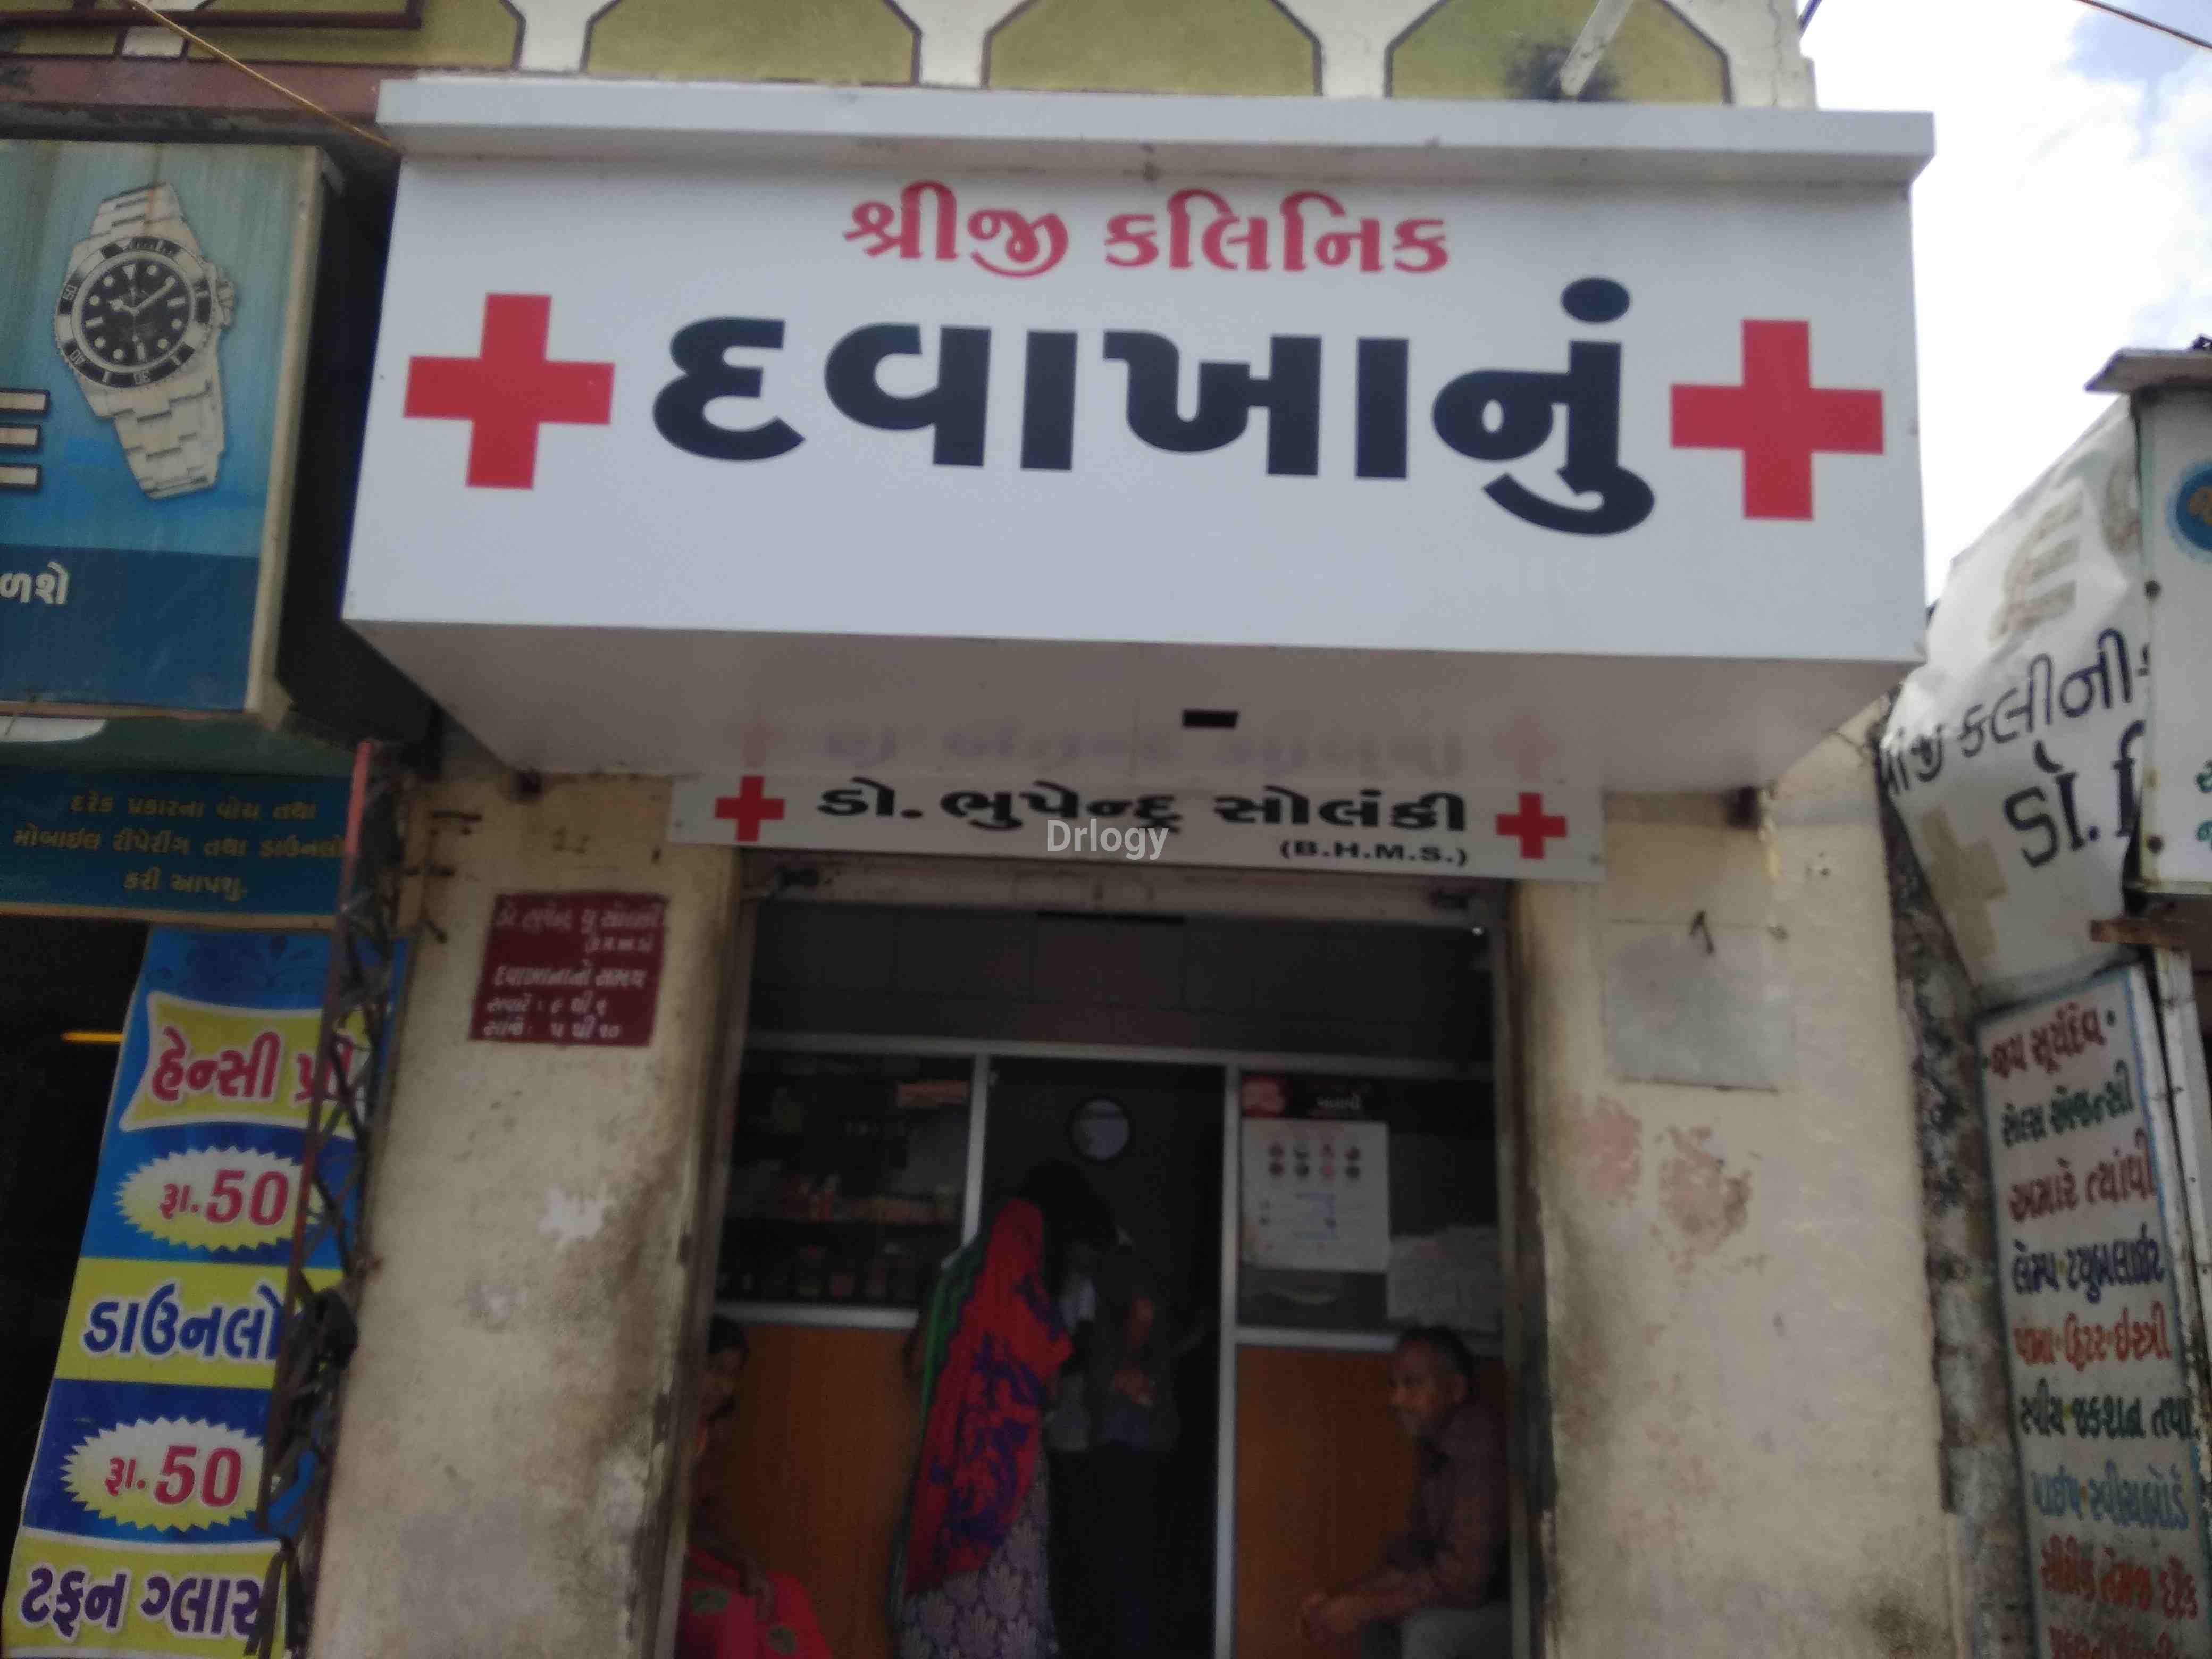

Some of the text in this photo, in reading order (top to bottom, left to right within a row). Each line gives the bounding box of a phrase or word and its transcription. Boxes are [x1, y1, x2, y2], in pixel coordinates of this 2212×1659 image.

[843, 181, 1069, 278] શ્રીજી
[651, 275, 1656, 535] દવાખાનું
[1957, 627, 2150, 758] કલીની
[817, 776, 923, 818] ડો.
[1213, 784, 1466, 832] સોલંકી
[1280, 839, 1467, 867] (B.H.M.S.)
[83, 1282, 286, 1360] ડાઉનલો
